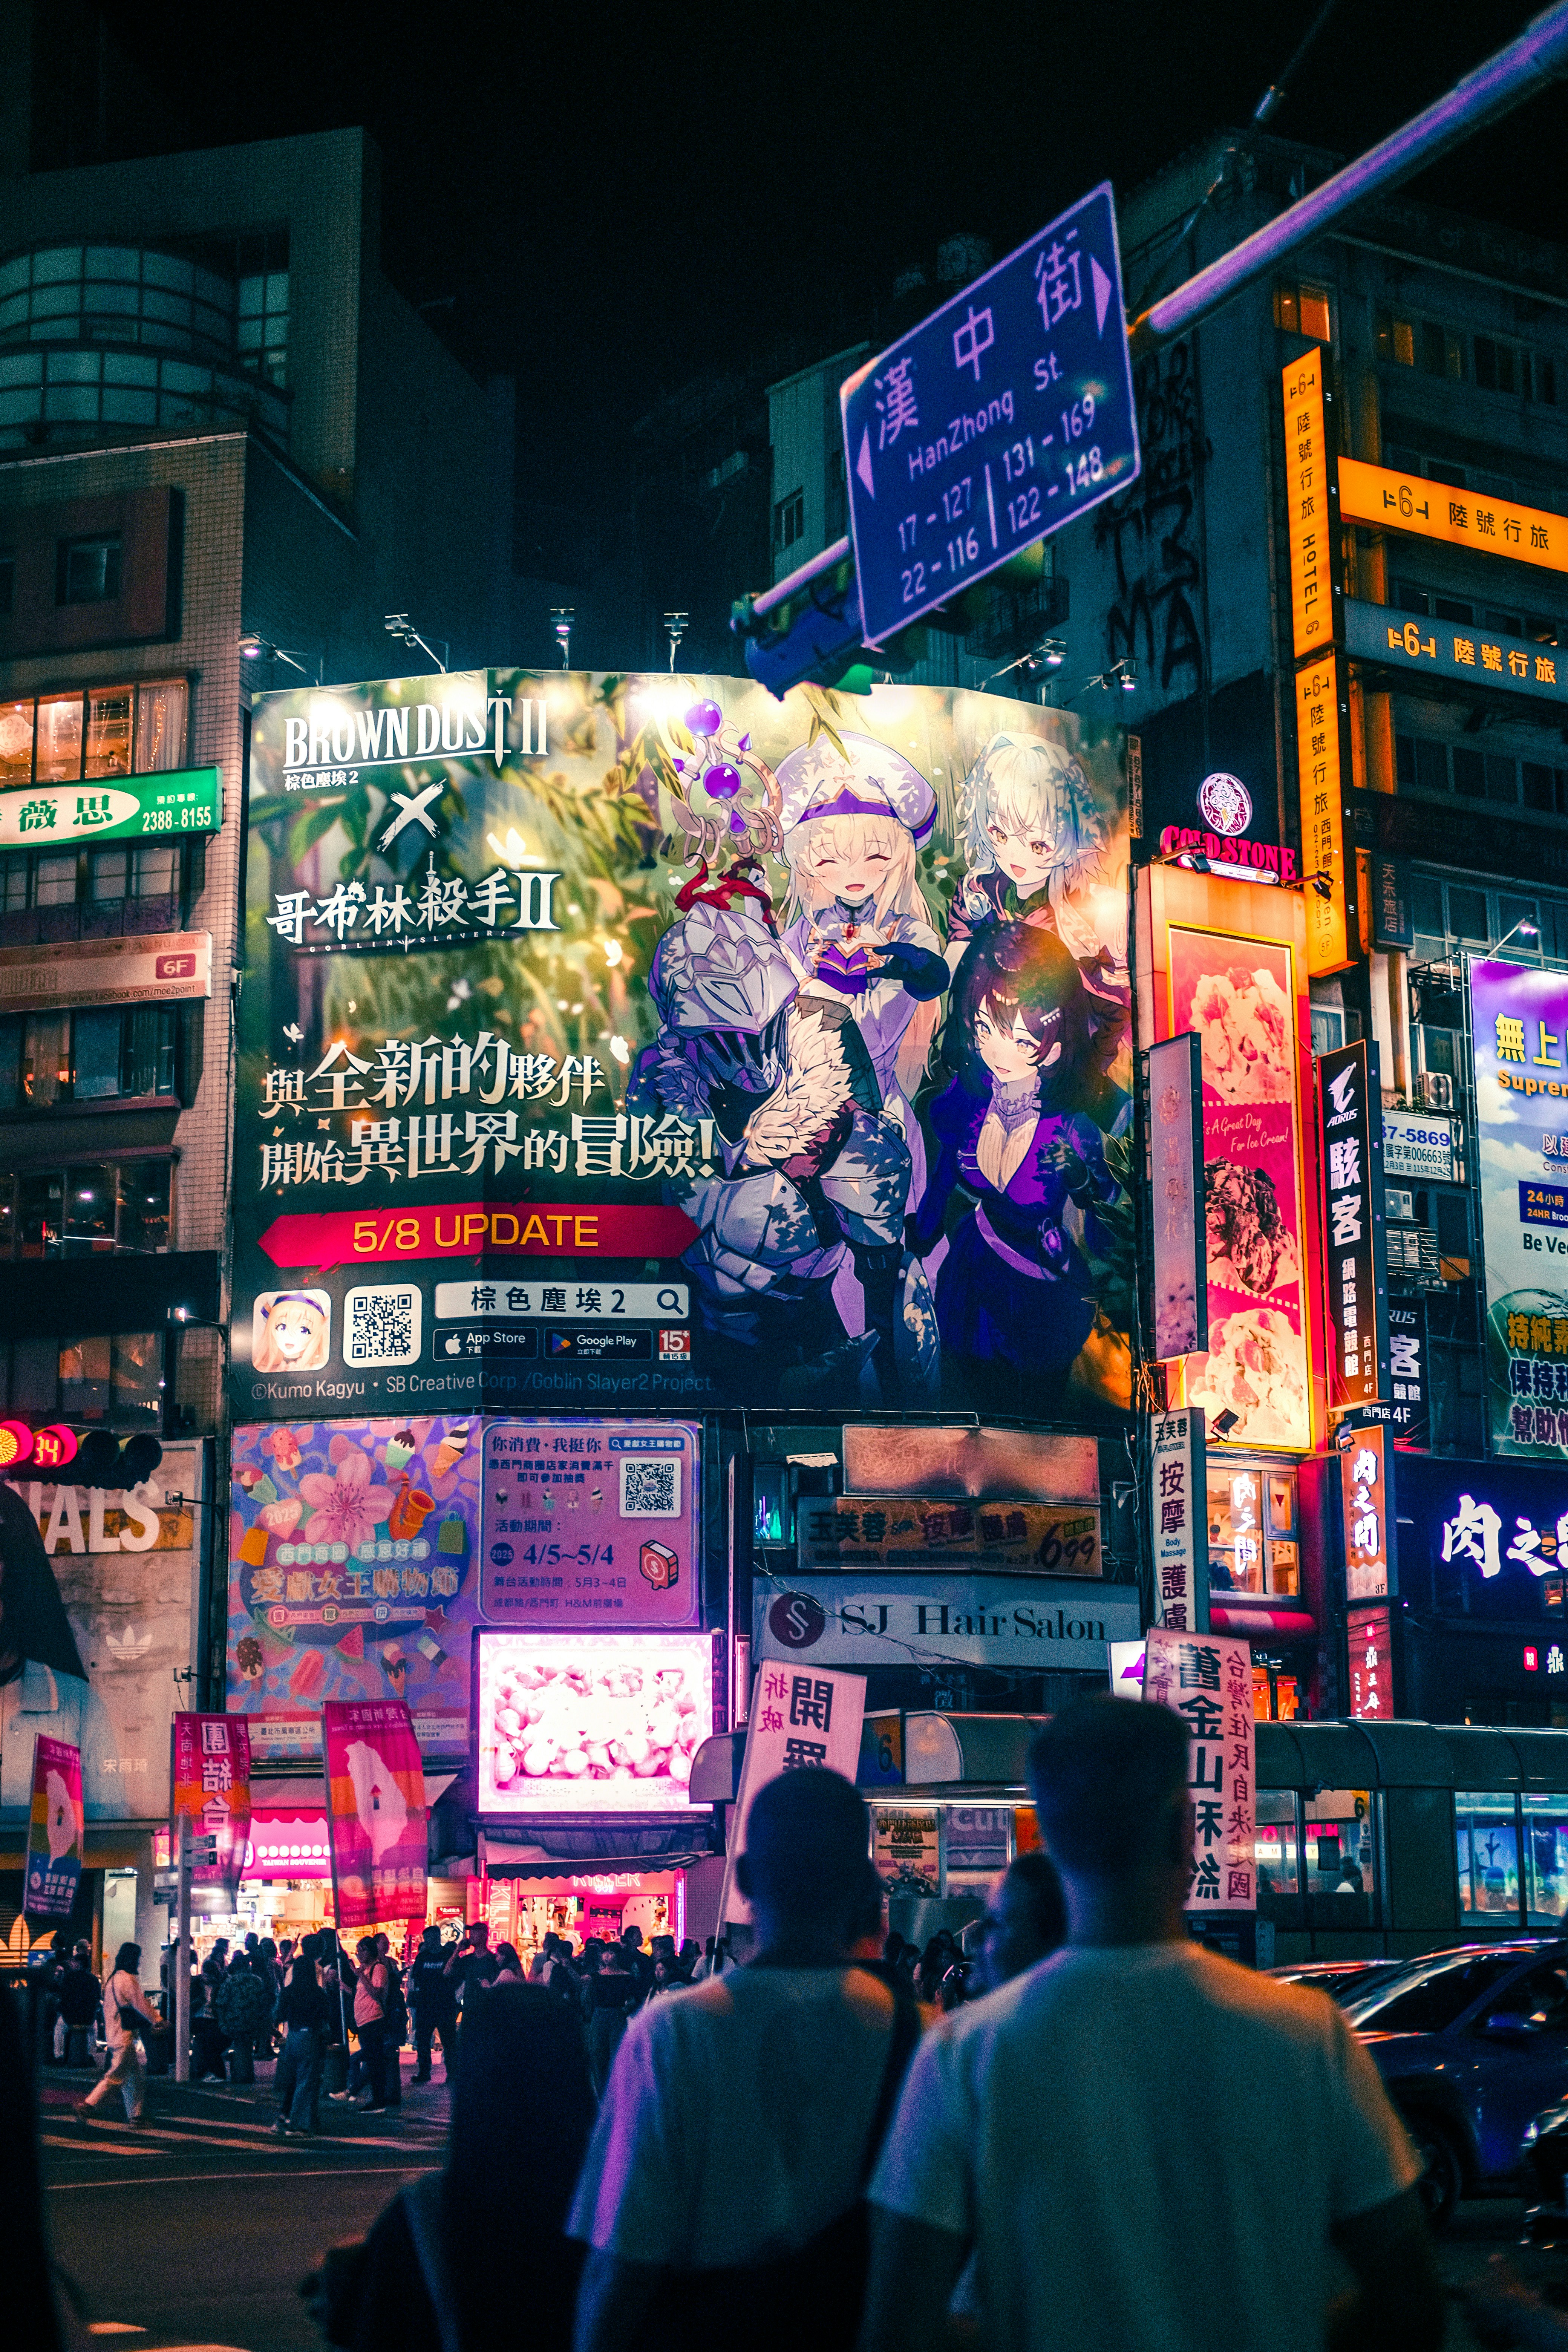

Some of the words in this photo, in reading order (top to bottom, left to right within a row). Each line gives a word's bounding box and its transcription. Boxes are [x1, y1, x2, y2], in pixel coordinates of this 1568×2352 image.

[874, 229, 1080, 450] 漢中街
[908, 391, 1014, 481] HanZhong
[1034, 352, 1062, 390] St.
[1297, 412, 1314, 519] 陸號行旅
[1449, 502, 1549, 550] 陸號行旅
[1303, 533, 1318, 614] HOTEL
[1454, 637, 1556, 684] 陸號行旅
[283, 707, 412, 768] BROWN
[415, 690, 512, 767] DUST
[520, 698, 549, 755] II
[1310, 704, 1328, 816] 陸號行旅
[284, 771, 358, 791] 棕色塵埃2
[0, 797, 113, 832] 薇思
[143, 807, 211, 831] 2388-8155
[1159, 825, 1220, 859] COLD
[1220, 837, 1296, 880] STONE
[1321, 818, 1332, 868] 西門館
[309, 940, 392, 952] GOBLIN
[420, 931, 505, 943] SLAYER!
[1321, 941, 1329, 952] 5F
[163, 960, 188, 974] 6F
[1496, 1013, 1568, 1068] 無上
[258, 1031, 605, 1119] 與全新的夥伴
[1211, 1119, 1219, 1134] A
[1221, 1117, 1243, 1136] Great
[1245, 1113, 1262, 1132] Day
[1326, 1109, 1358, 1128] AORUS
[259, 1109, 716, 1191] 開始異世界的冒險!
[1231, 1137, 1245, 1152] For
[1247, 1135, 1259, 1149] Ice
[1260, 1127, 1288, 1147] Cream!
[1329, 1137, 1363, 1246] 駭客
[1527, 1190, 1564, 1207] 24小時
[1527, 1208, 1550, 1219] 24HR
[353, 1219, 419, 1253] 5/8
[435, 1213, 599, 1247] UPDATE
[1524, 1233, 1542, 1251] Be
[1545, 1236, 1568, 1254] Ve
[471, 1286, 626, 1313] 棕色塵埃2
[1342, 1257, 1358, 1378] 網路電競館
[1389, 1310, 1418, 1324] RUS
[466, 1333, 490, 1344] App
[493, 1332, 525, 1343] Store
[577, 1335, 613, 1348] Google
[616, 1337, 637, 1348] Play
[1390, 1334, 1421, 1378] 客
[316, 1381, 365, 1397] Kagyu
[386, 1376, 406, 1392] SB
[410, 1373, 475, 1391] Creative
[588, 1372, 649, 1392] Slayer2
[1364, 1382, 1373, 1393] 4F
[1363, 1406, 1390, 1419] 西門店
[1393, 1407, 1411, 1423] 4F
[1155, 1418, 1187, 1442] 玉芙蓉
[1159, 1461, 1185, 1534] 按摩
[1353, 1449, 1378, 1557] 肉之間
[266, 1505, 300, 1527] 2025
[808, 1511, 886, 1543] 玉芙蓉
[1233, 1473, 1257, 1575] 肉之間
[280, 1545, 346, 1562] 西門商圈
[1161, 1547, 1187, 1557] Massage
[1166, 1538, 1181, 1548] Body
[1161, 1564, 1187, 1631] 護膚
[1375, 1583, 1385, 1594] 3F
[840, 1605, 894, 1635] SJ
[912, 1605, 1006, 1636] Hair
[1014, 1607, 1106, 1640] Salon
[103, 1759, 148, 1774] 宋雨琦
